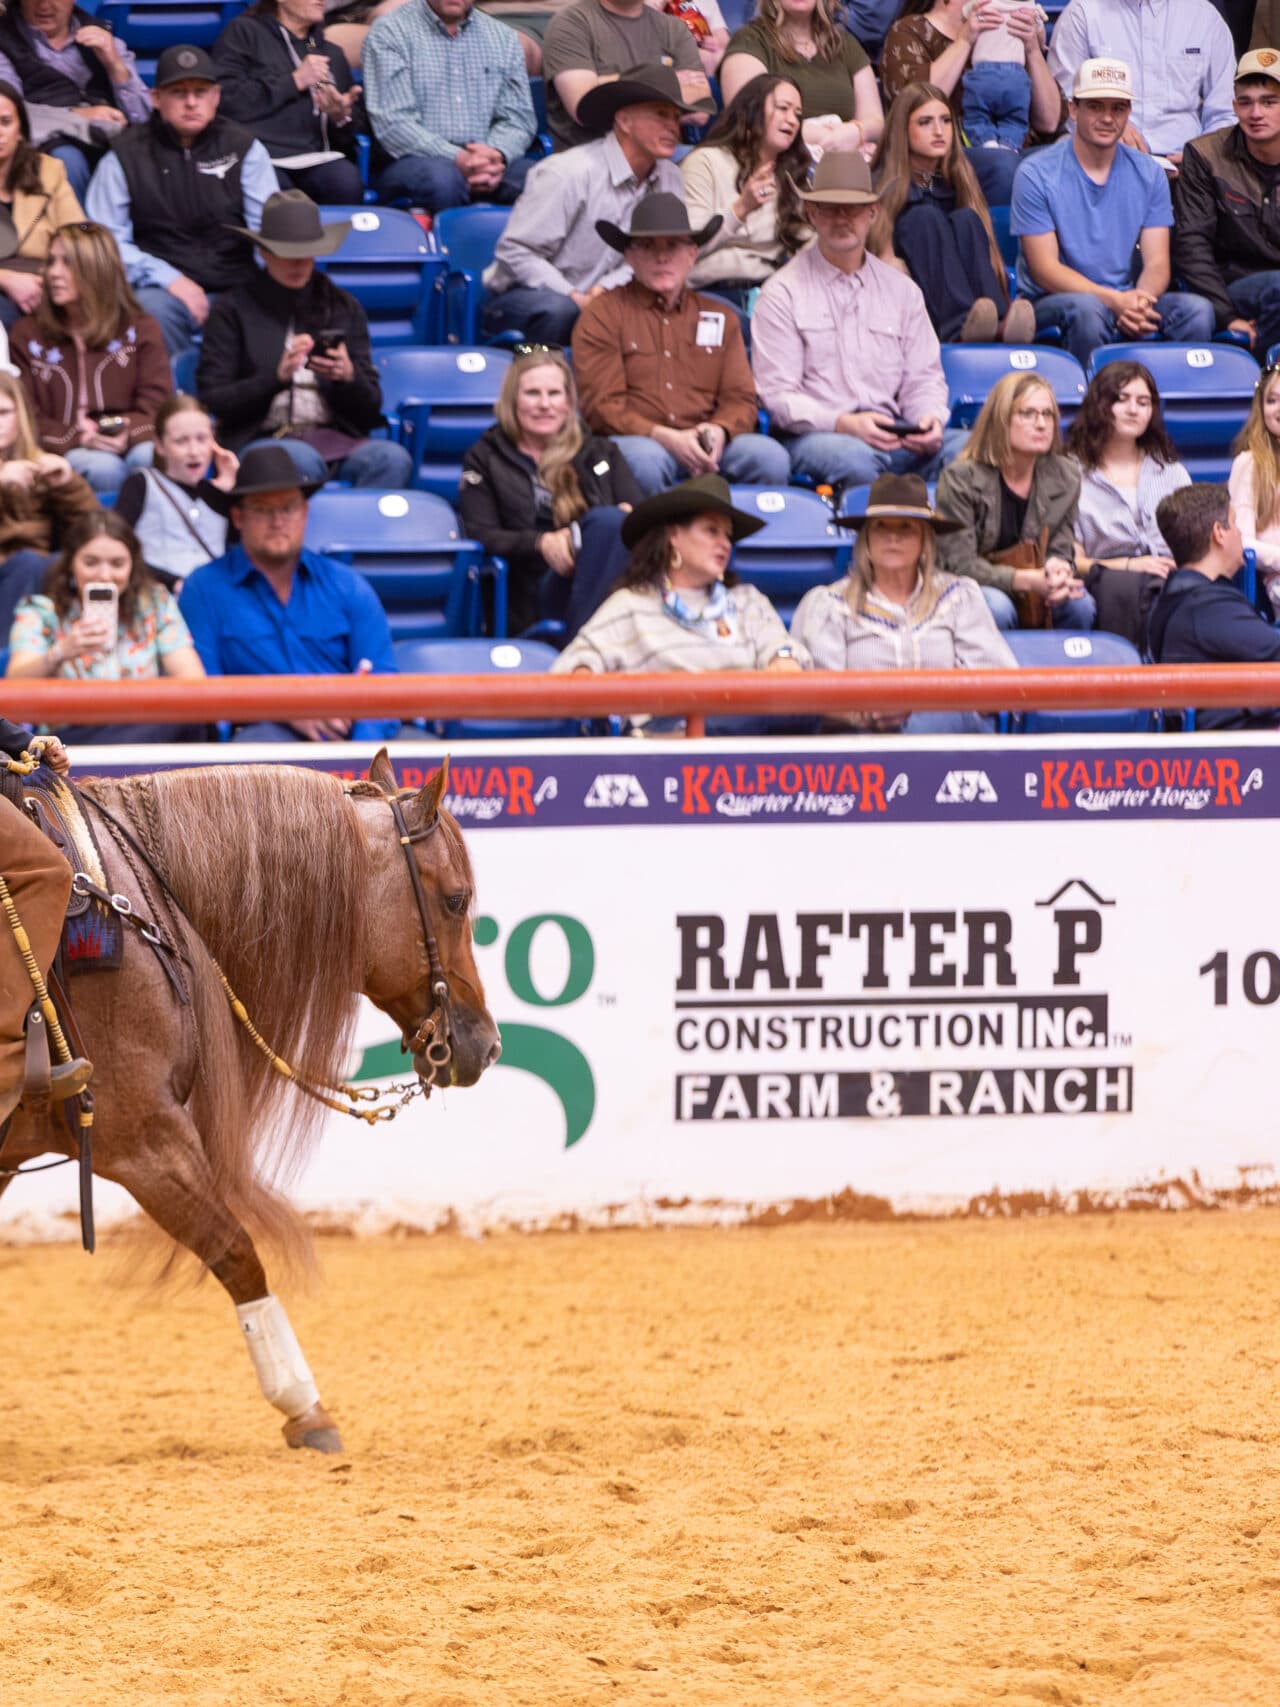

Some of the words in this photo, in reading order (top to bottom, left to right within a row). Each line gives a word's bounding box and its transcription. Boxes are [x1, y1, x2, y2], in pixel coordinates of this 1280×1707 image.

[682, 763, 888, 814] KALPOWAR
[715, 792, 793, 817] Quarter
[794, 791, 856, 816] Horses
[1041, 758, 1243, 809] KALPOWAR
[1075, 787, 1150, 811] Quarter
[1151, 785, 1211, 810] Horses
[675, 910, 1017, 991] RAFTER
[1053, 908, 1103, 986] P
[675, 1012, 1004, 1052] CONSTRUCTION
[1022, 1005, 1107, 1049] INC.
[680, 1071, 840, 1121] FARM
[866, 1069, 904, 1119] &
[929, 1066, 1129, 1116] RANCH
